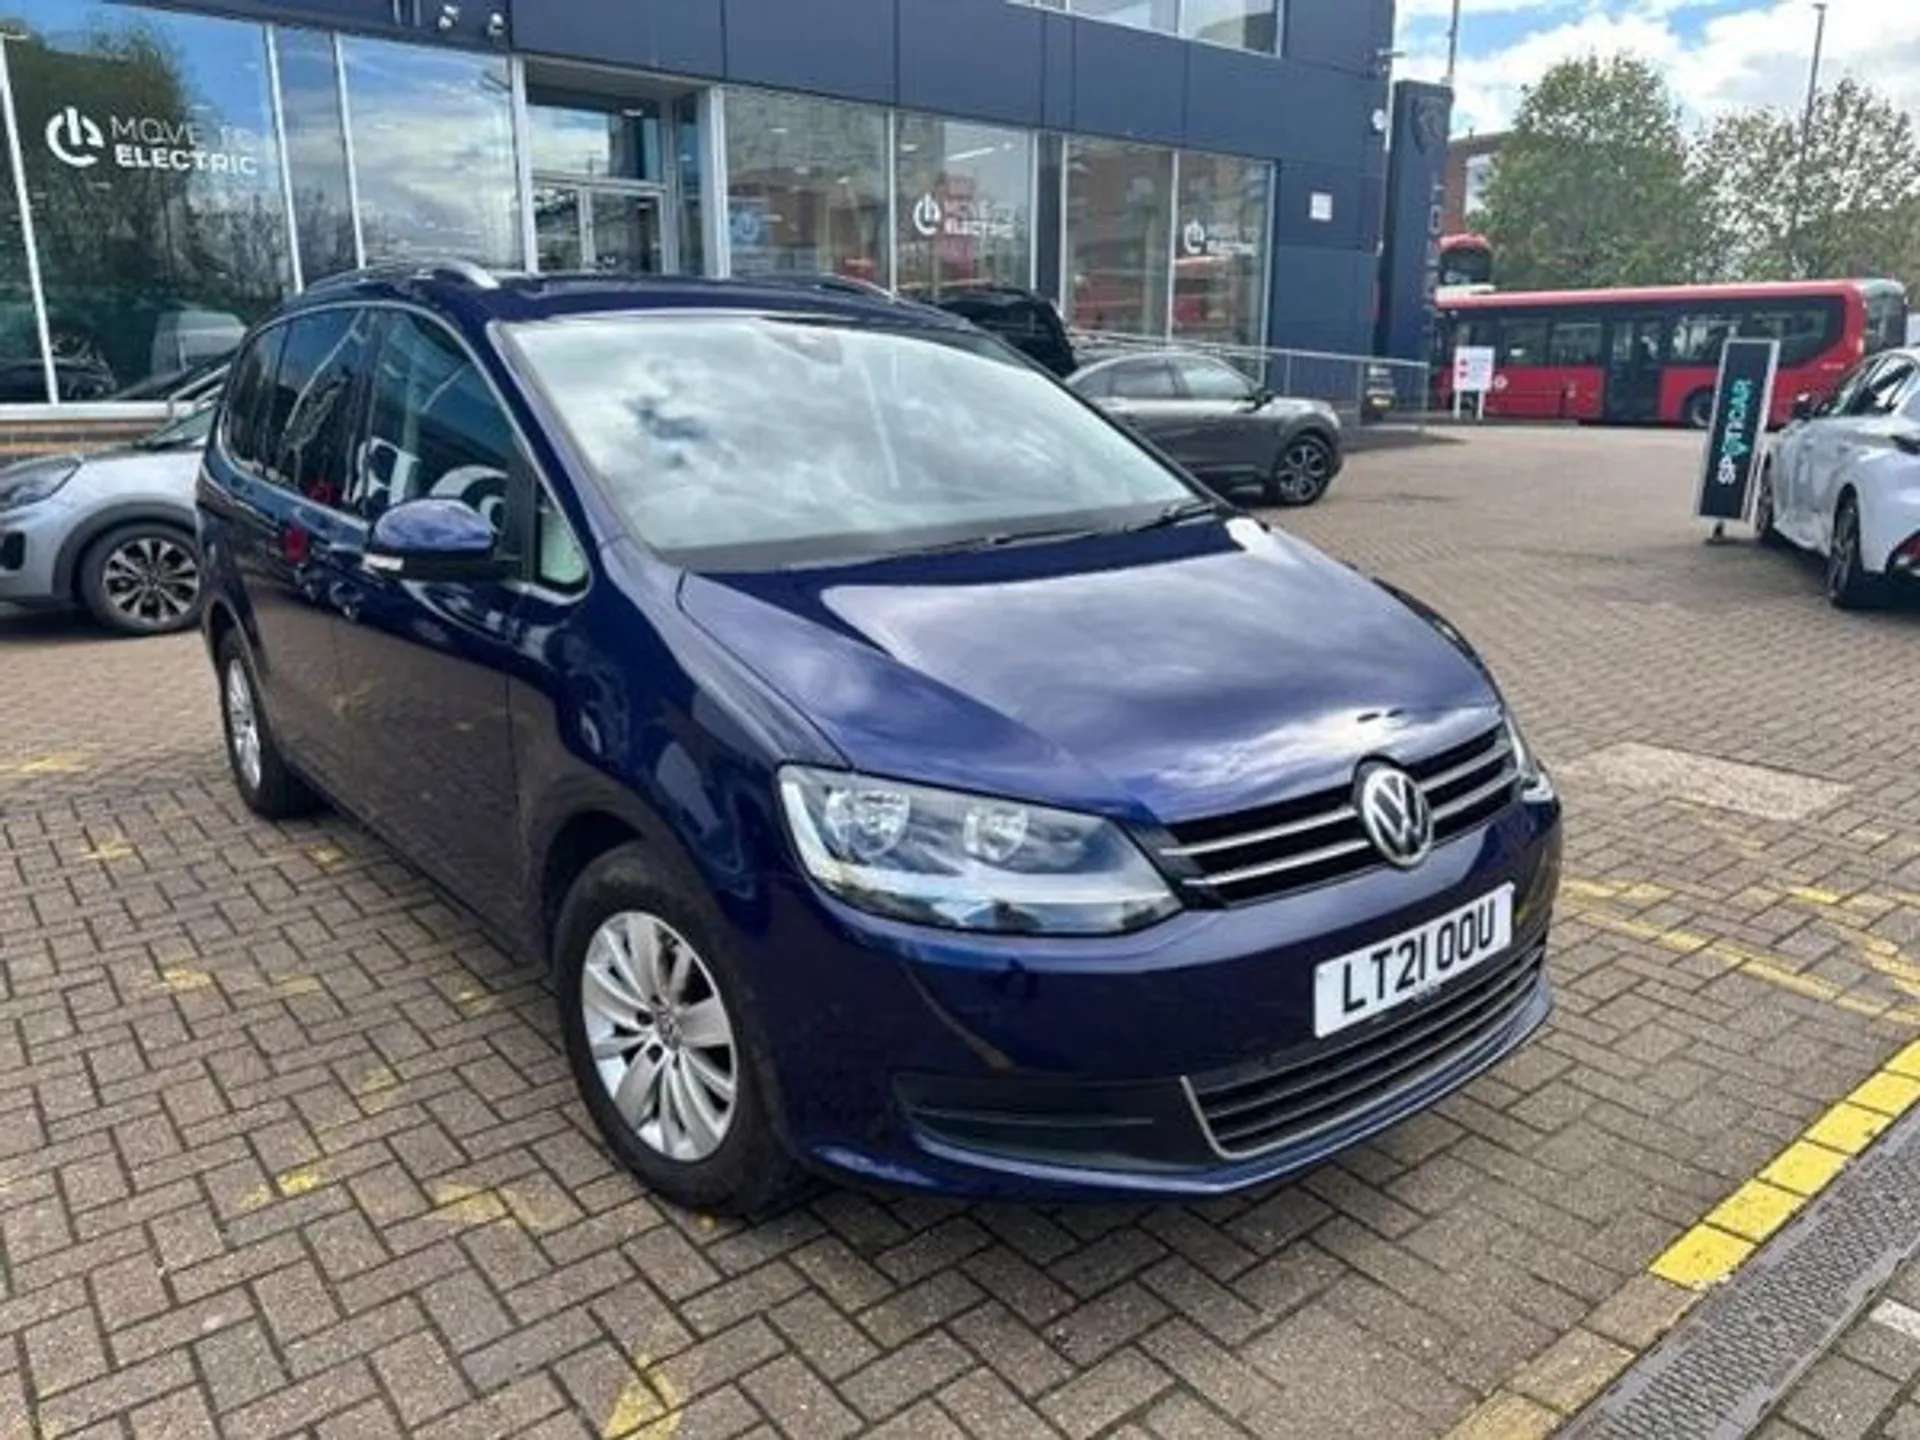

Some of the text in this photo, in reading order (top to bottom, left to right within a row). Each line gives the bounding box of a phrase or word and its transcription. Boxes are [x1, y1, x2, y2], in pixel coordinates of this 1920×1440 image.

[110, 115, 206, 146] MOVE
[114, 143, 259, 176] ELECTRIC
[1342, 931, 1428, 1013] LT21
